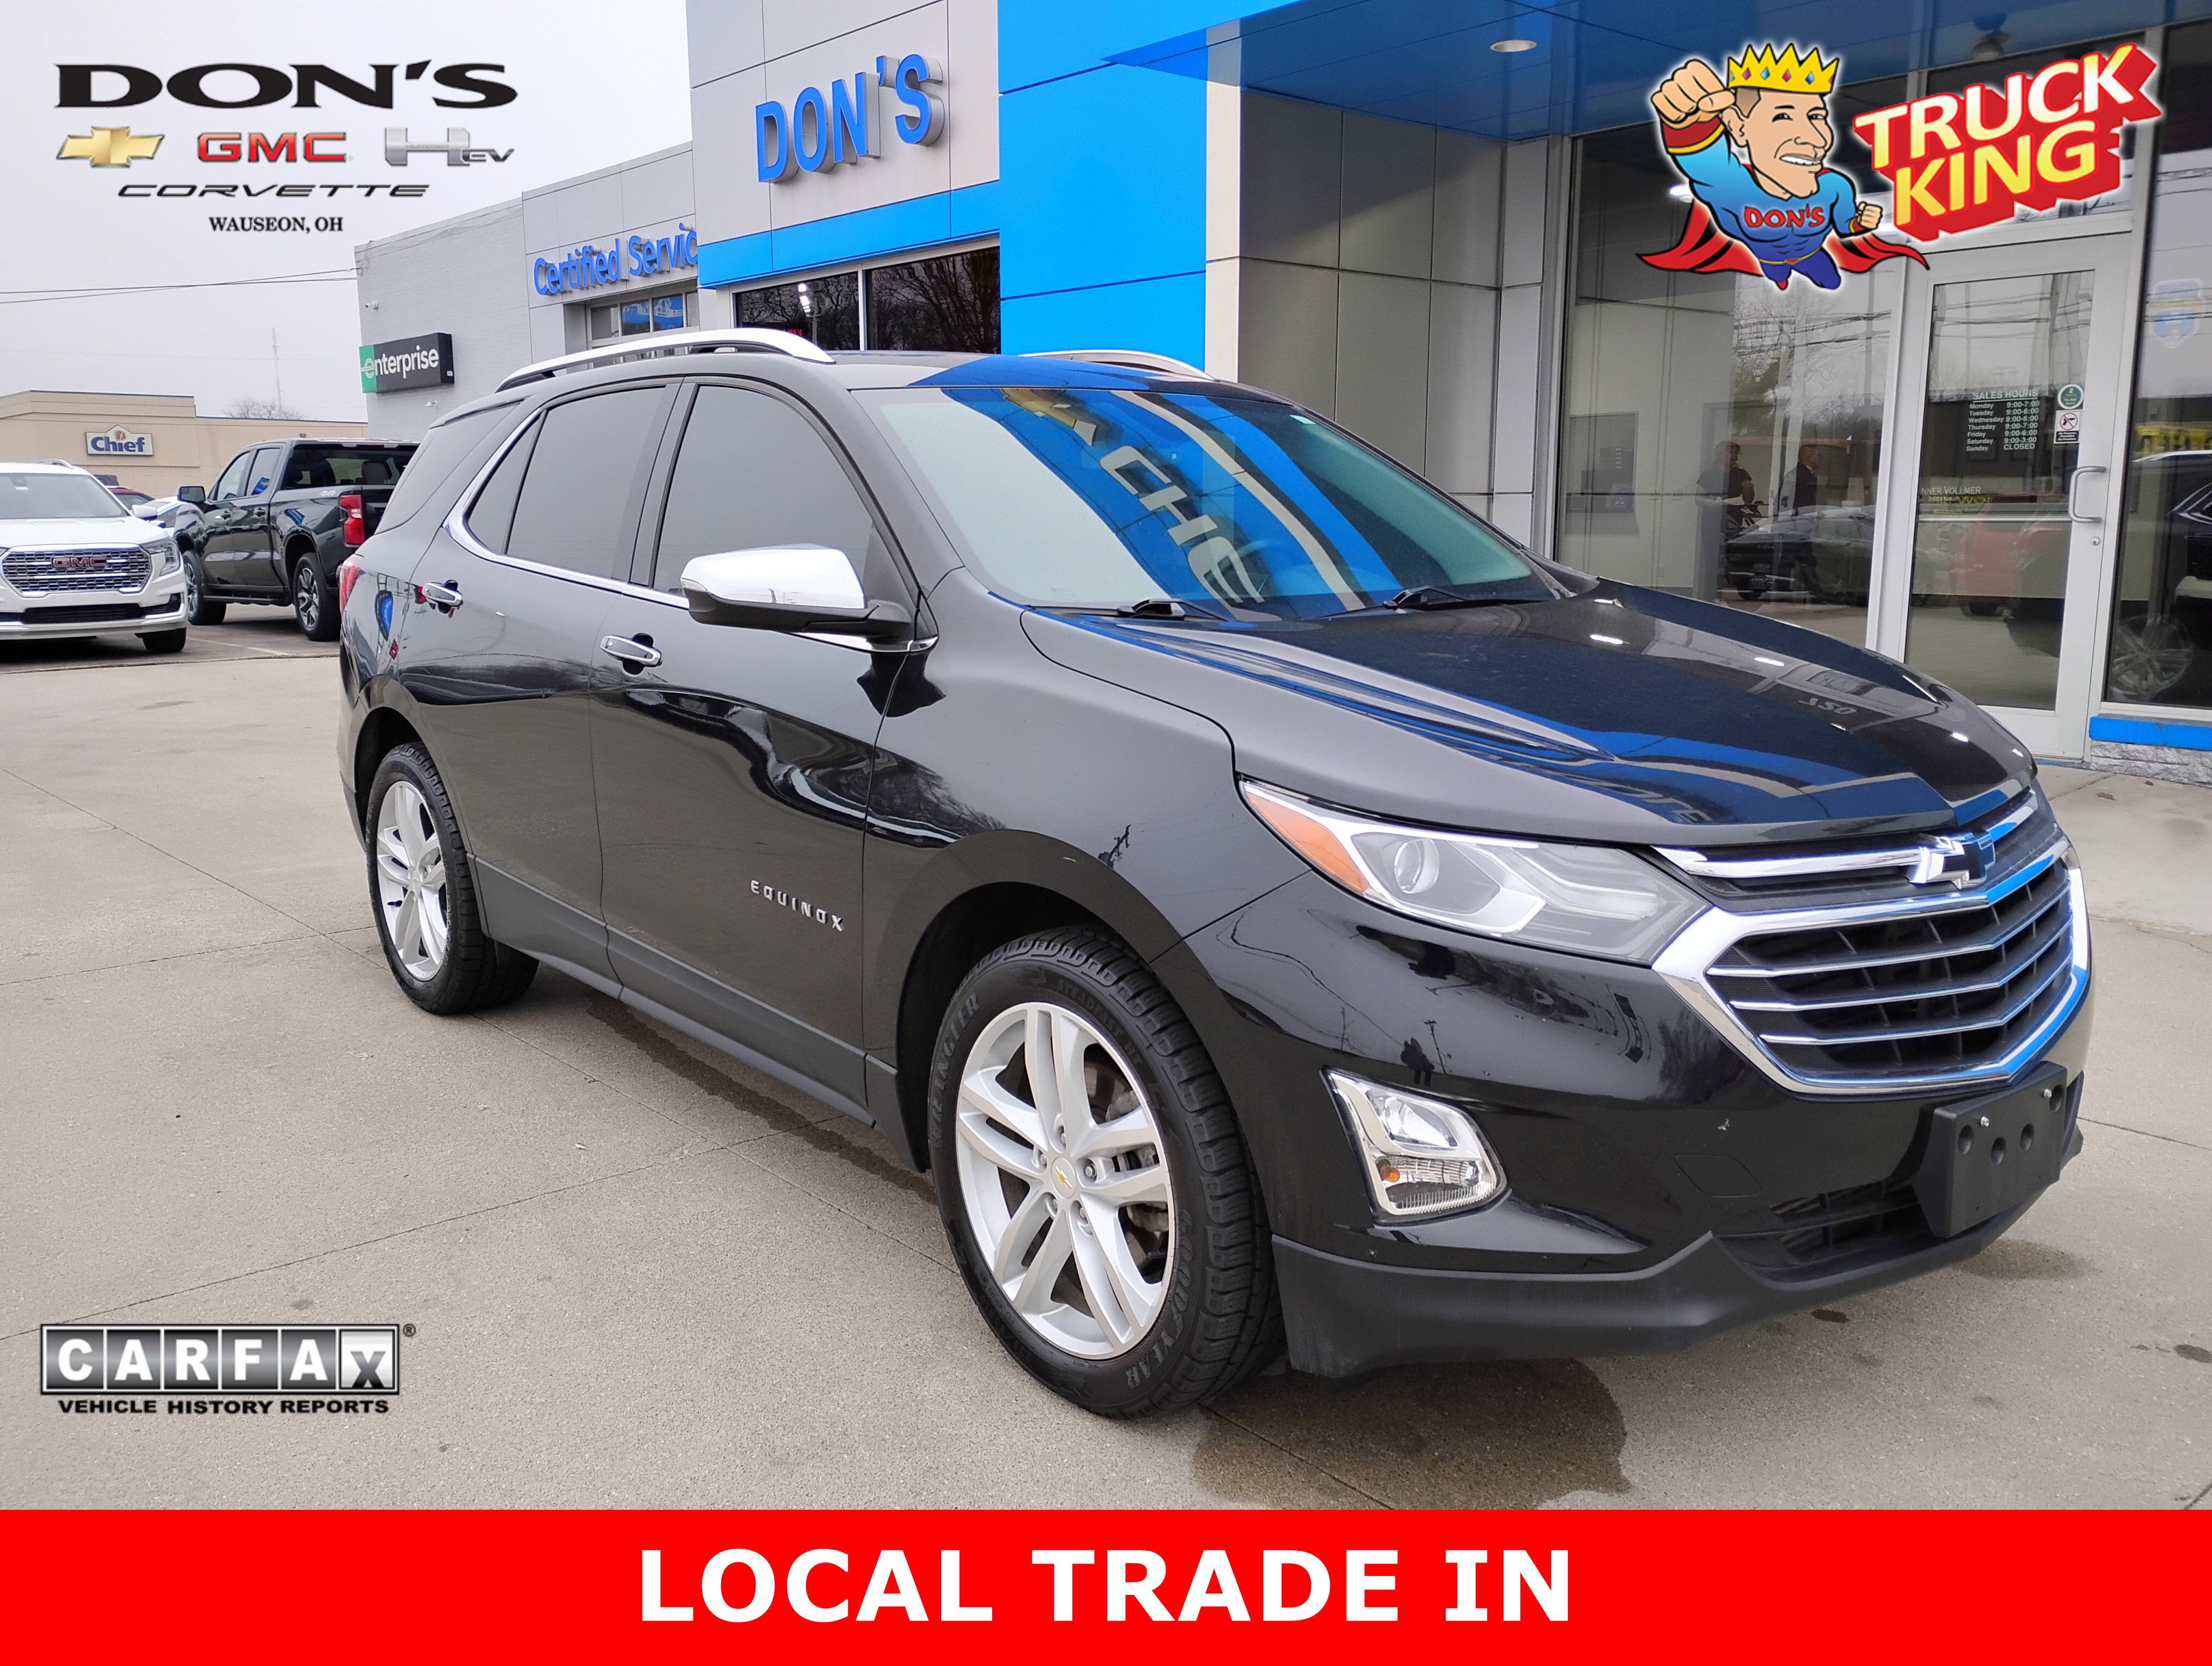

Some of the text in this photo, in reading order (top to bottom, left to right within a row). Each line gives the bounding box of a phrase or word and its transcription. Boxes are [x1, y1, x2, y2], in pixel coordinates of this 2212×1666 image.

[755, 53, 942, 182] DON'S
[533, 239, 621, 295] Certified
[361, 344, 439, 379] enterprise
[1973, 389, 2038, 400] SALES HOURS
[91, 436, 145, 452] Chief
[1944, 486, 1982, 495] VOLLMER
[53, 557, 107, 568] GMC
[750, 879, 845, 932] EQUINOX
[931, 992, 981, 1149] WRANGLER
